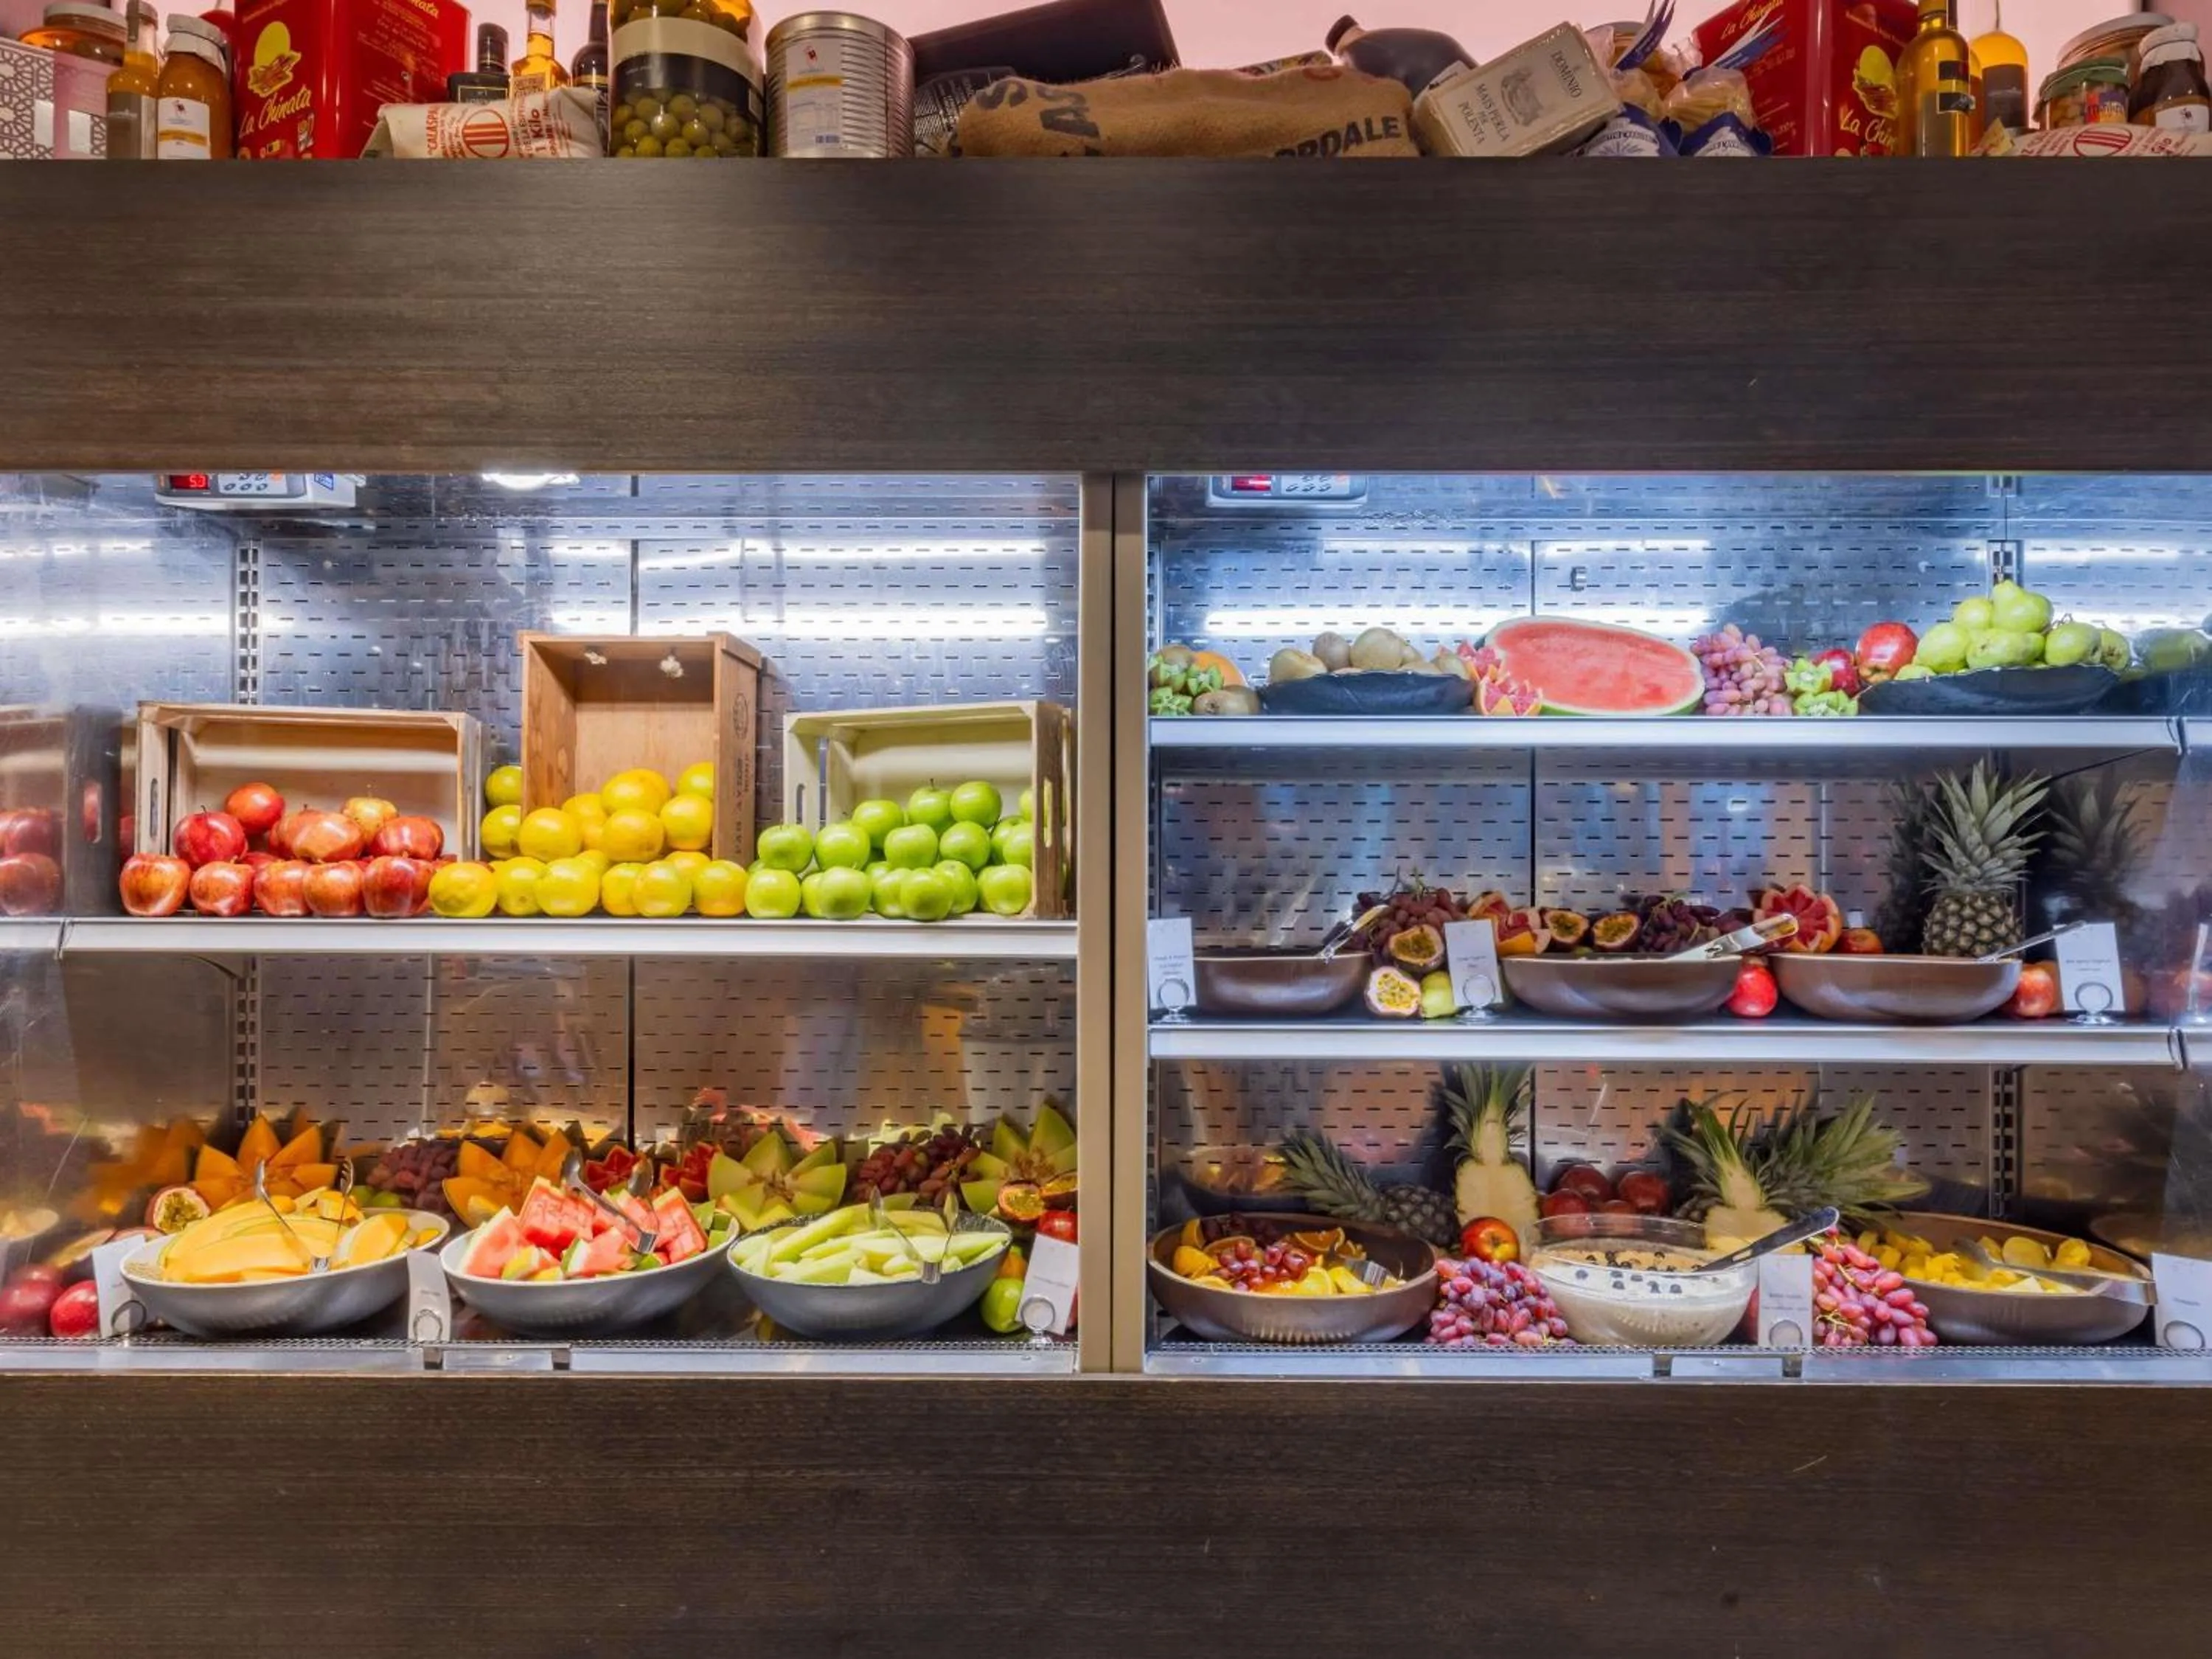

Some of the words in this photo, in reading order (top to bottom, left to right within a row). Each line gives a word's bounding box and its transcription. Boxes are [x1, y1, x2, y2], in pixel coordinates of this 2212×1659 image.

[1551, 49, 1583, 98] DOMINIO
[238, 111, 255, 139] La
[258, 83, 312, 131] Chinata
[528, 108, 544, 139] Kilo
[1840, 108, 1860, 136] La
